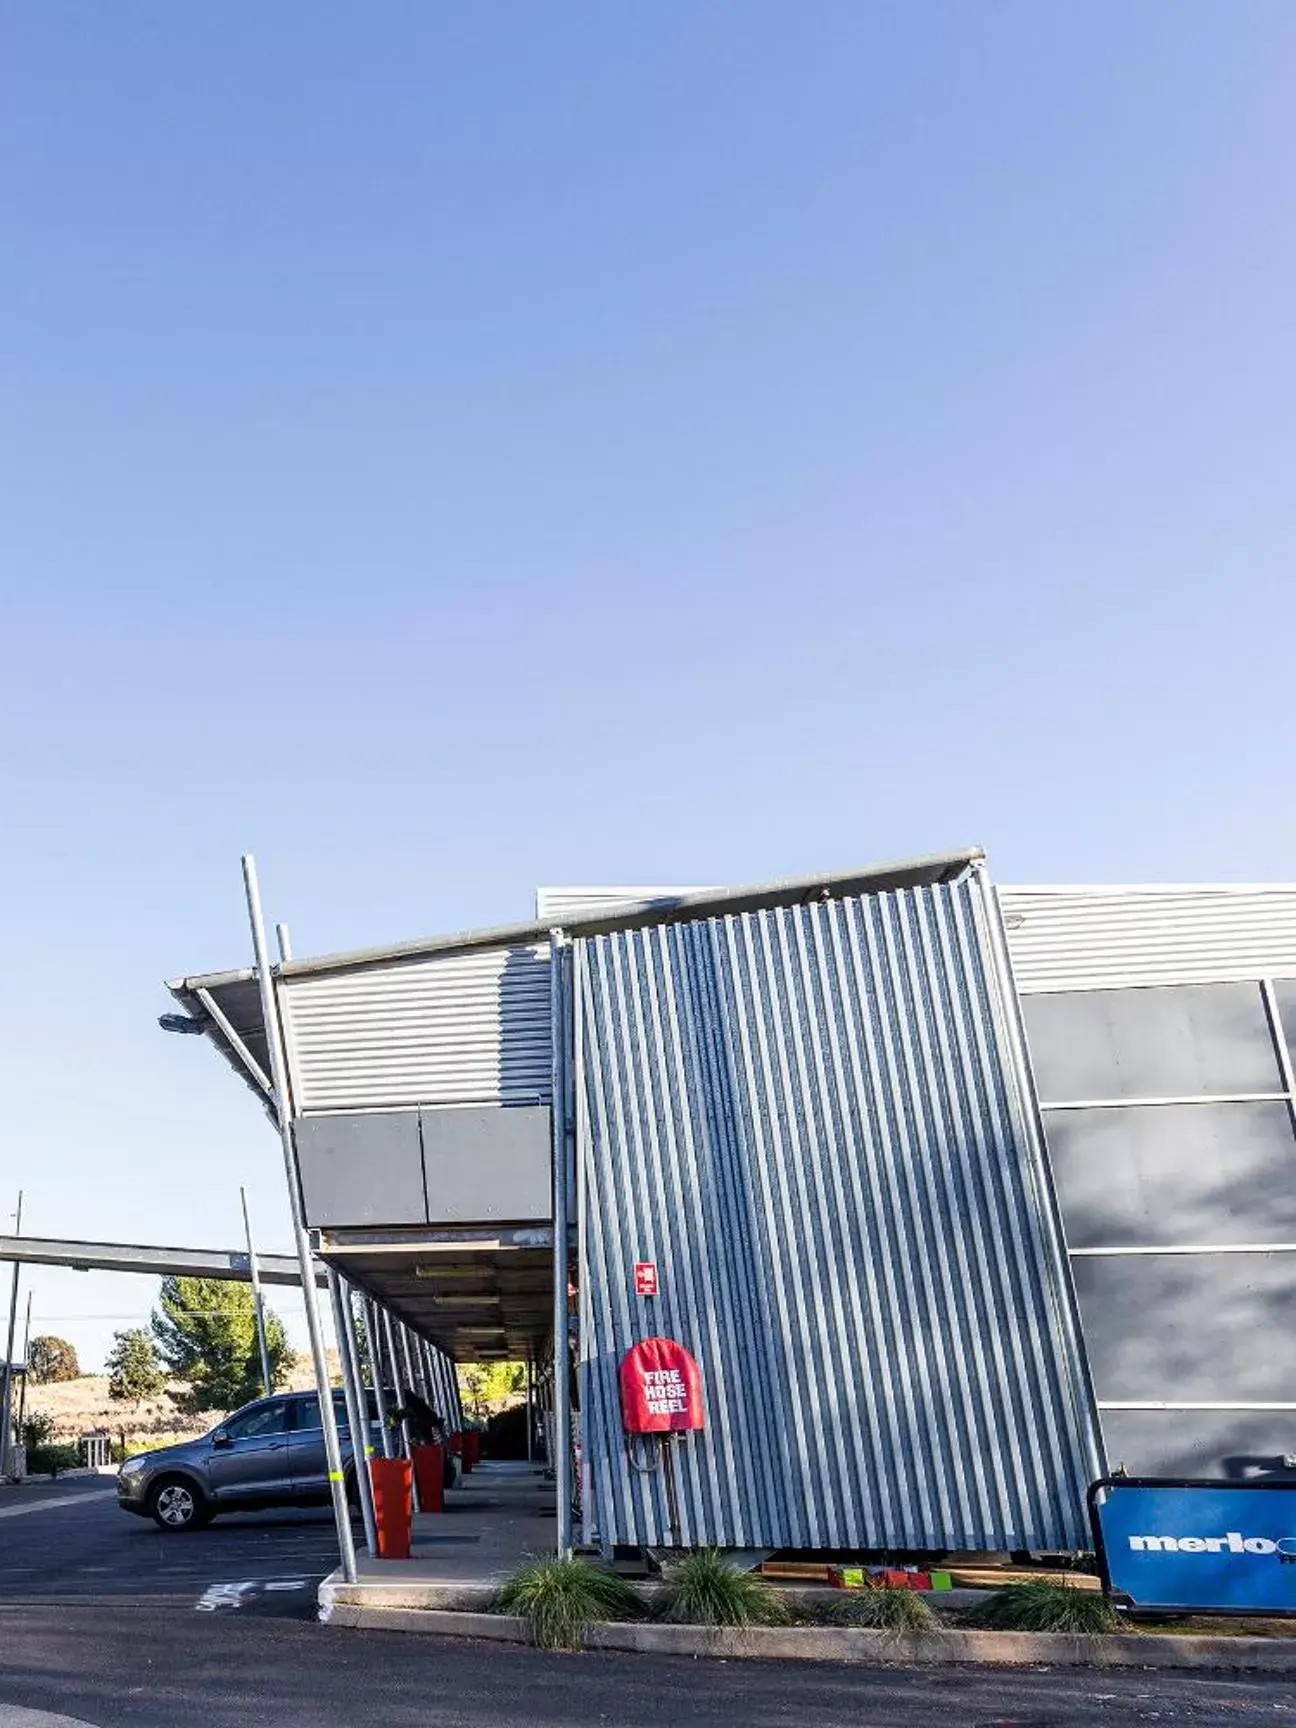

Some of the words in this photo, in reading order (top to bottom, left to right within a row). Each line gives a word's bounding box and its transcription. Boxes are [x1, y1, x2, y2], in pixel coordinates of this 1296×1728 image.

[645, 1370, 681, 1385] FIRE
[645, 1384, 687, 1399] HOSE
[647, 1399, 688, 1414] REEL
